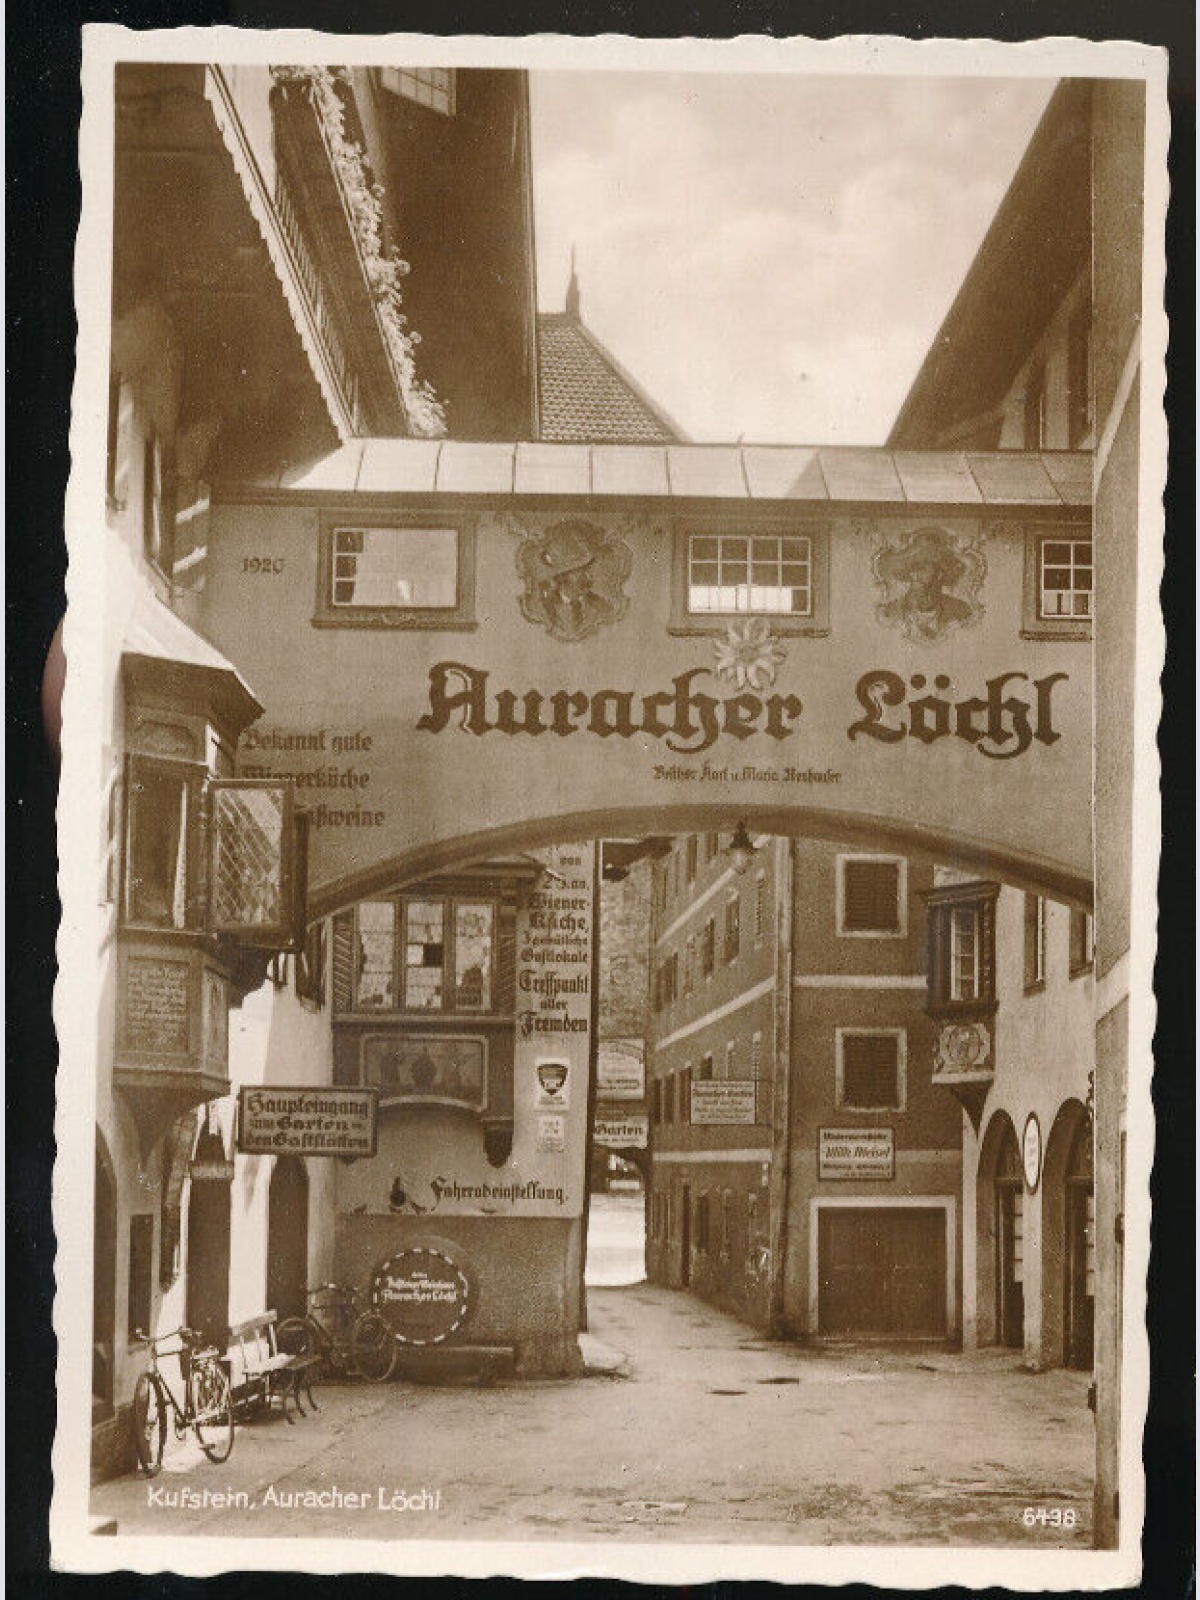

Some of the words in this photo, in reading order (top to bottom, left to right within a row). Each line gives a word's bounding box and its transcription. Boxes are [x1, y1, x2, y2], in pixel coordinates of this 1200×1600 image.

[415, 661, 804, 754] Auracher
[846, 669, 1069, 760] Löchl
[332, 731, 373, 755] gute
[518, 969, 589, 997] Treffpunkt
[519, 1011, 588, 1037] Fremden
[247, 1092, 369, 1120] Haupteingang
